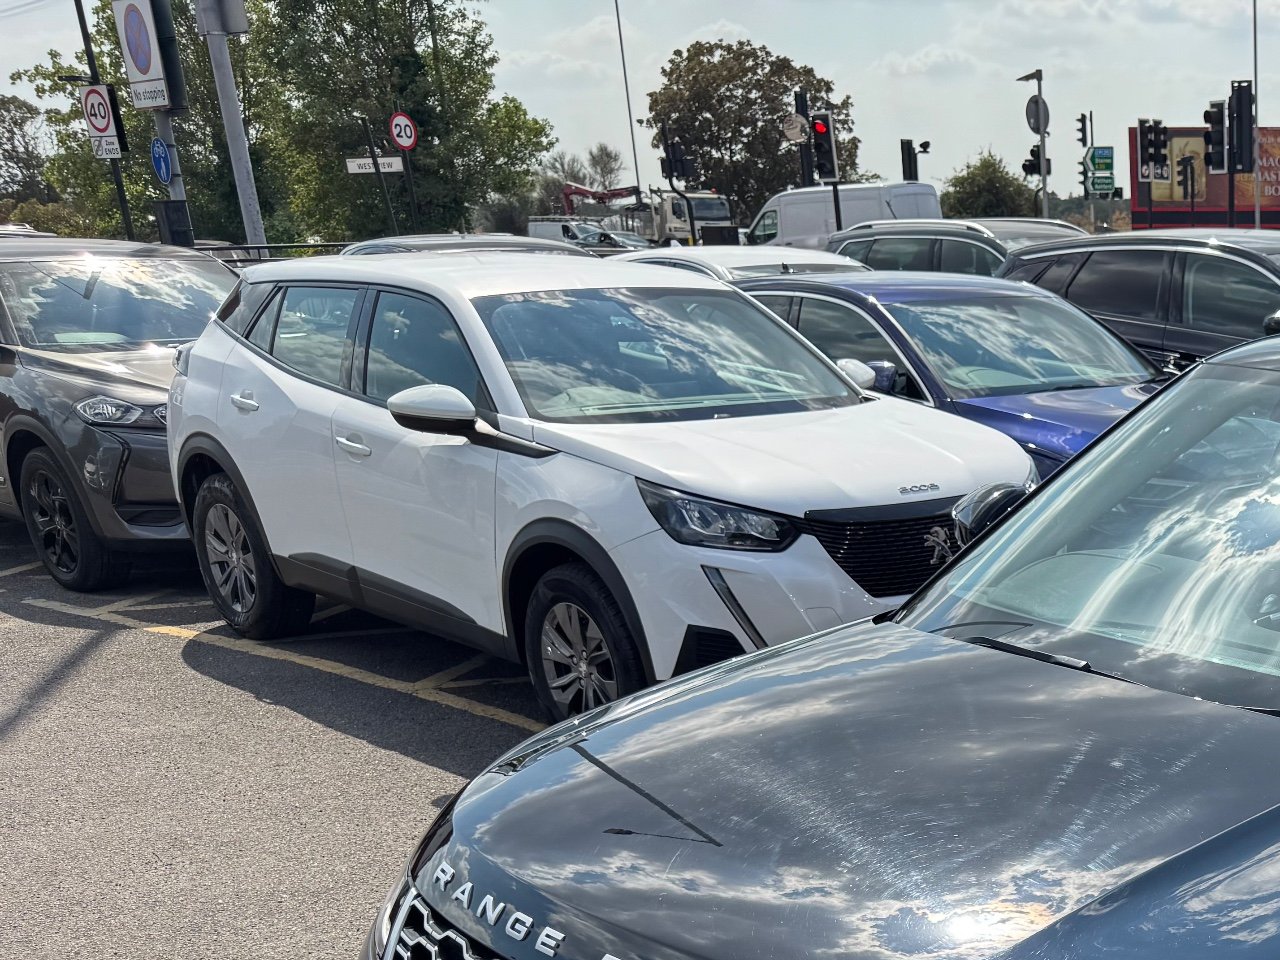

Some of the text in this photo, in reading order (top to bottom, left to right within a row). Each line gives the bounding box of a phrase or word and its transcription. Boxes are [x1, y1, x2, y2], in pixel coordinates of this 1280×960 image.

[134, 87, 166, 101] No stopping
[89, 101, 107, 120] 40
[394, 123, 413, 139] 20
[104, 147, 120, 155] ENDS
[356, 162, 375, 170] WEST
[433, 860, 566, 957] RANGE
